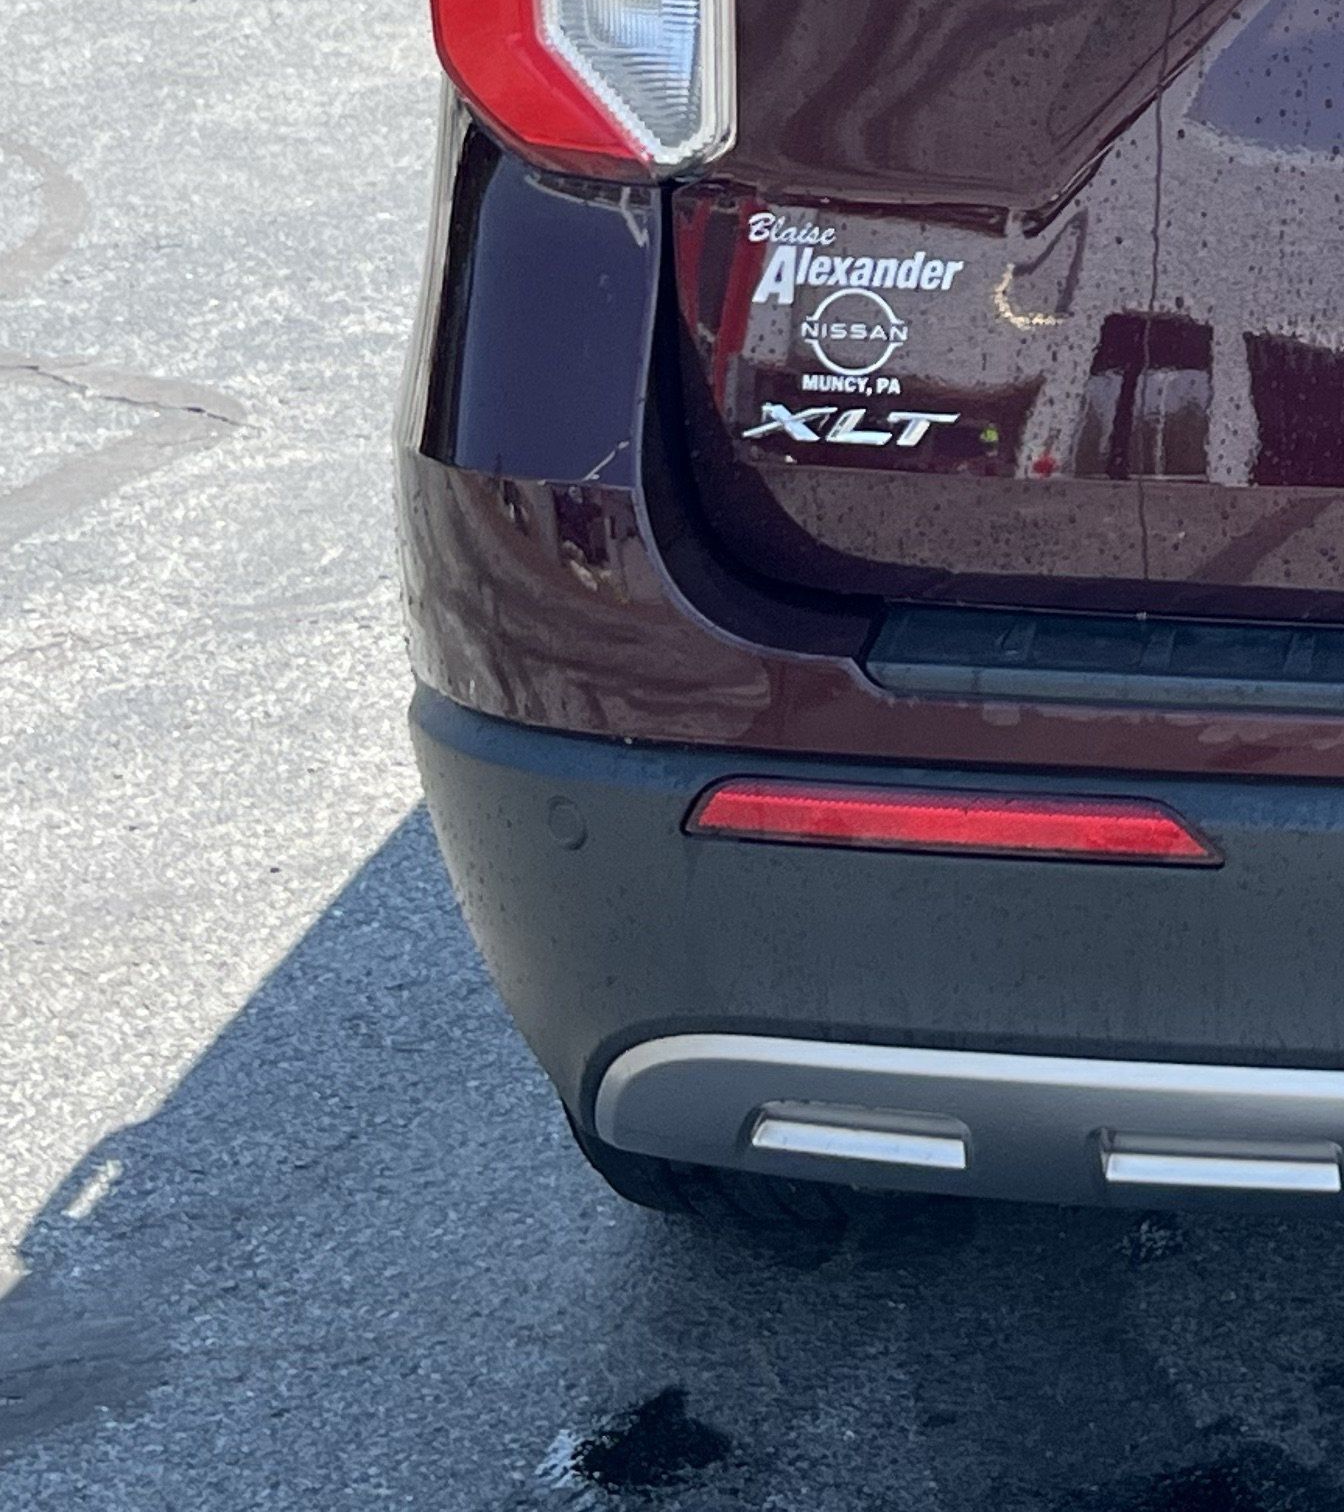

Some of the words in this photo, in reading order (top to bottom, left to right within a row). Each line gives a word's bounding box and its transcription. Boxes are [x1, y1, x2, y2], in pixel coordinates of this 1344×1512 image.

[748, 212, 837, 245] Blaise
[752, 246, 964, 304] Alexander
[801, 321, 909, 341] NISSAN
[802, 374, 873, 396] MUNCY,
[876, 377, 901, 395] PA
[743, 402, 961, 446] XLT
